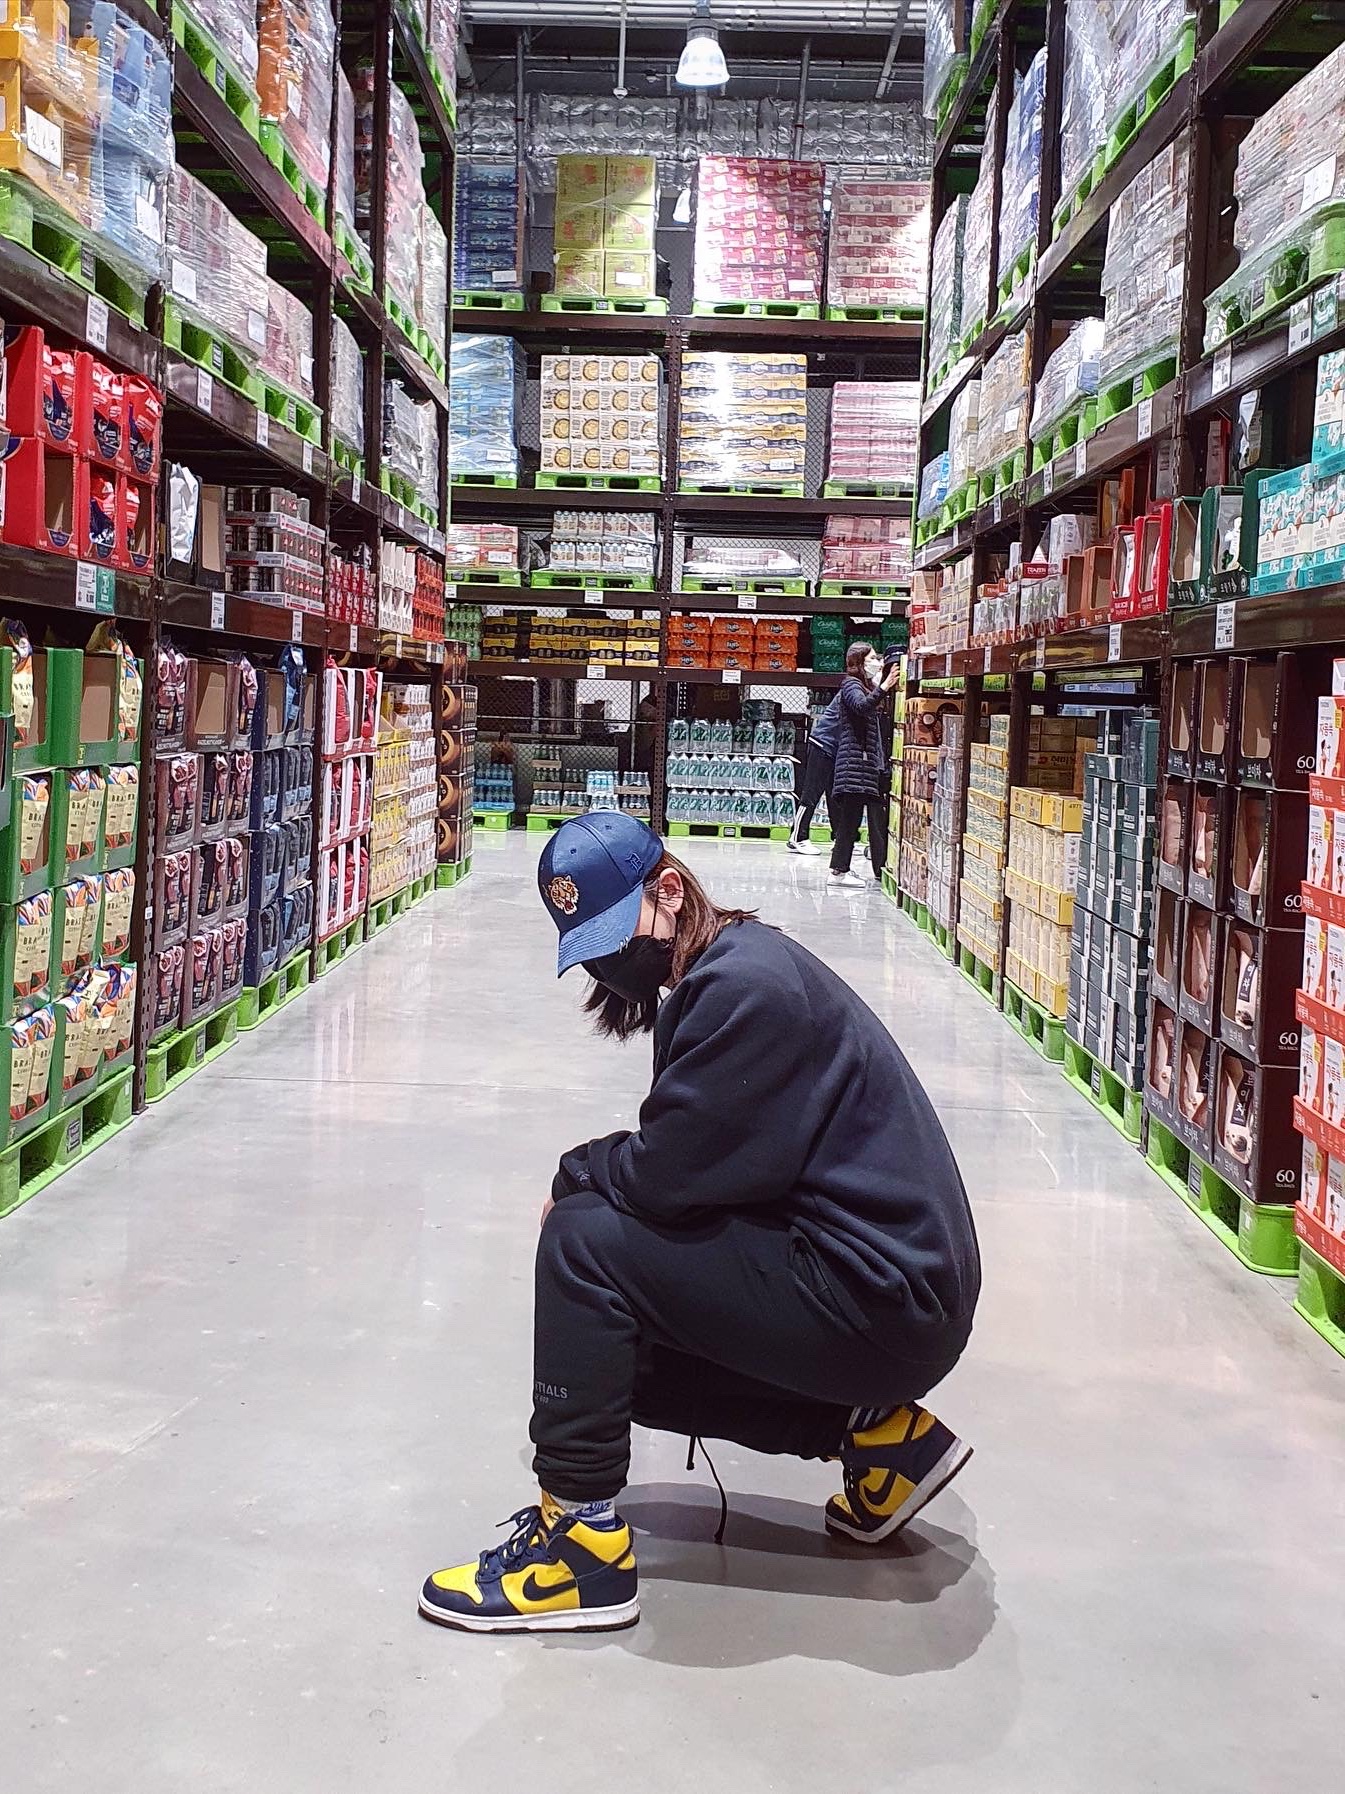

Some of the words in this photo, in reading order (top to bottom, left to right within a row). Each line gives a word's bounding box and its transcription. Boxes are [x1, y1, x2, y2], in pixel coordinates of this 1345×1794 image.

[1296, 755, 1315, 769] 60
[1284, 894, 1302, 908] 60
[1279, 1031, 1299, 1045] 60
[1275, 1169, 1296, 1183] 60
[535, 1381, 569, 1399] TIALS
